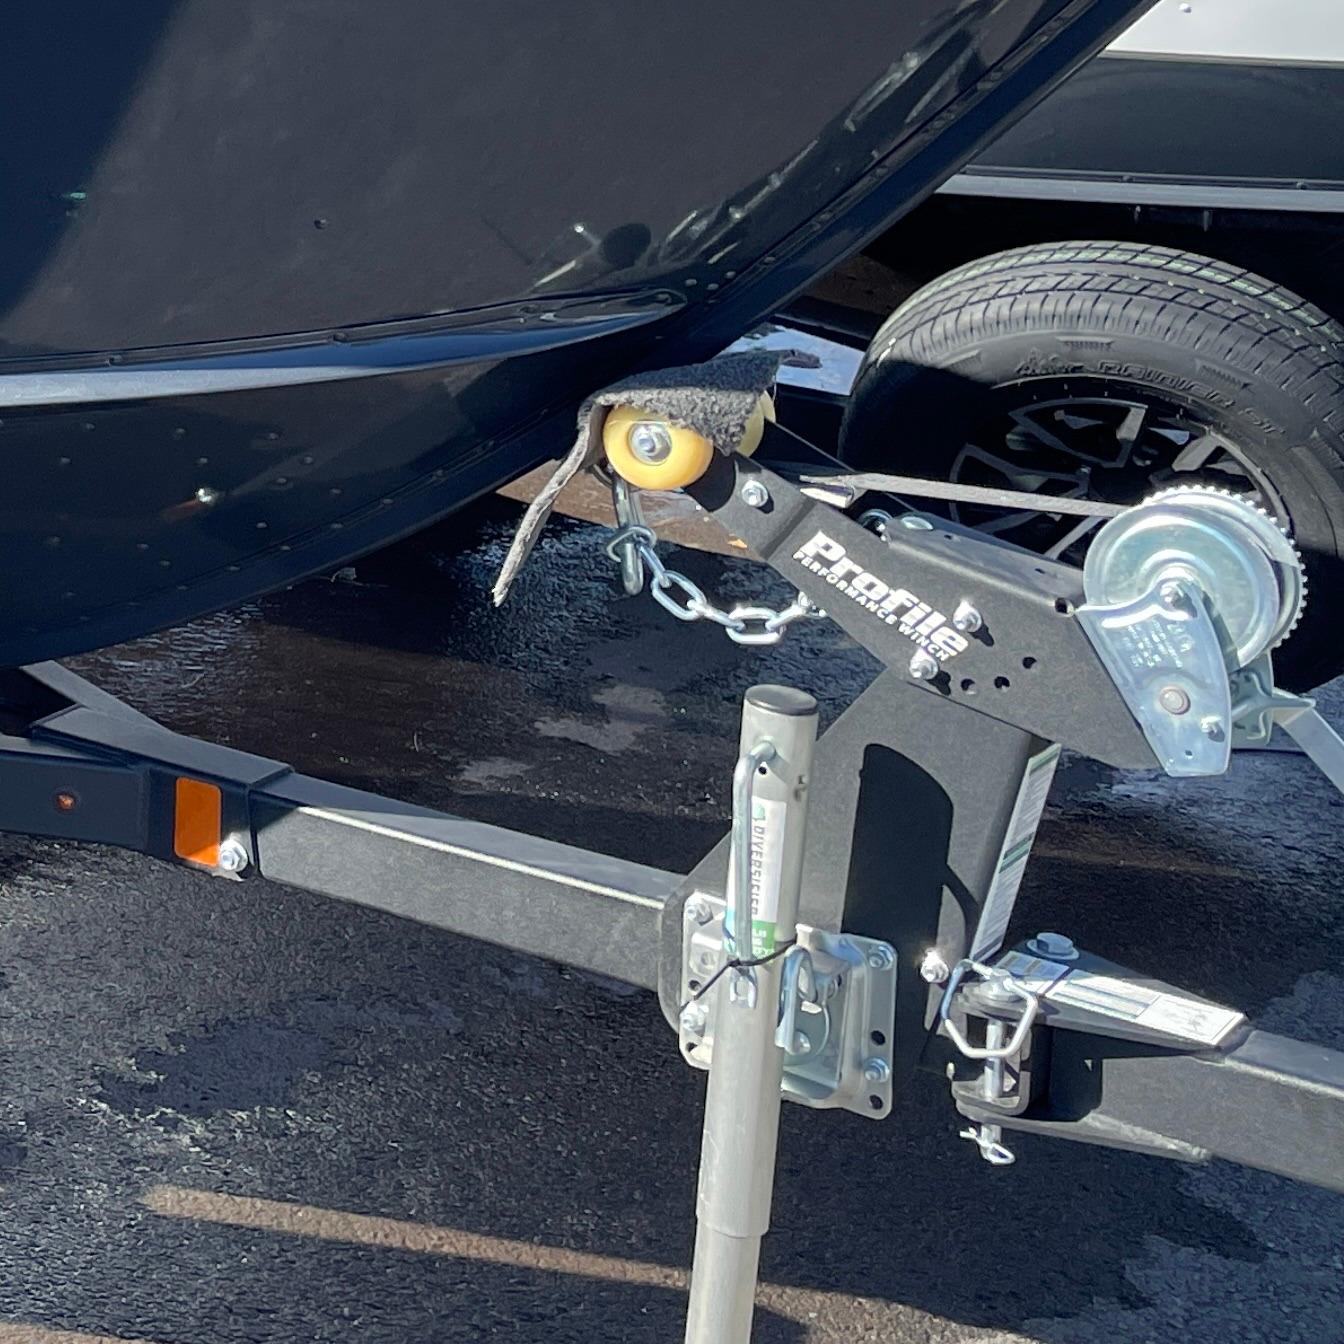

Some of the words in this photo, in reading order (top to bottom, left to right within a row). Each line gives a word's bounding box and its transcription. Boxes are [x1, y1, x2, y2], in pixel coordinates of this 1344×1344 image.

[792, 550, 898, 625] PERFORMANCE
[898, 621, 951, 662] WINCH
[799, 529, 969, 657] Profile
